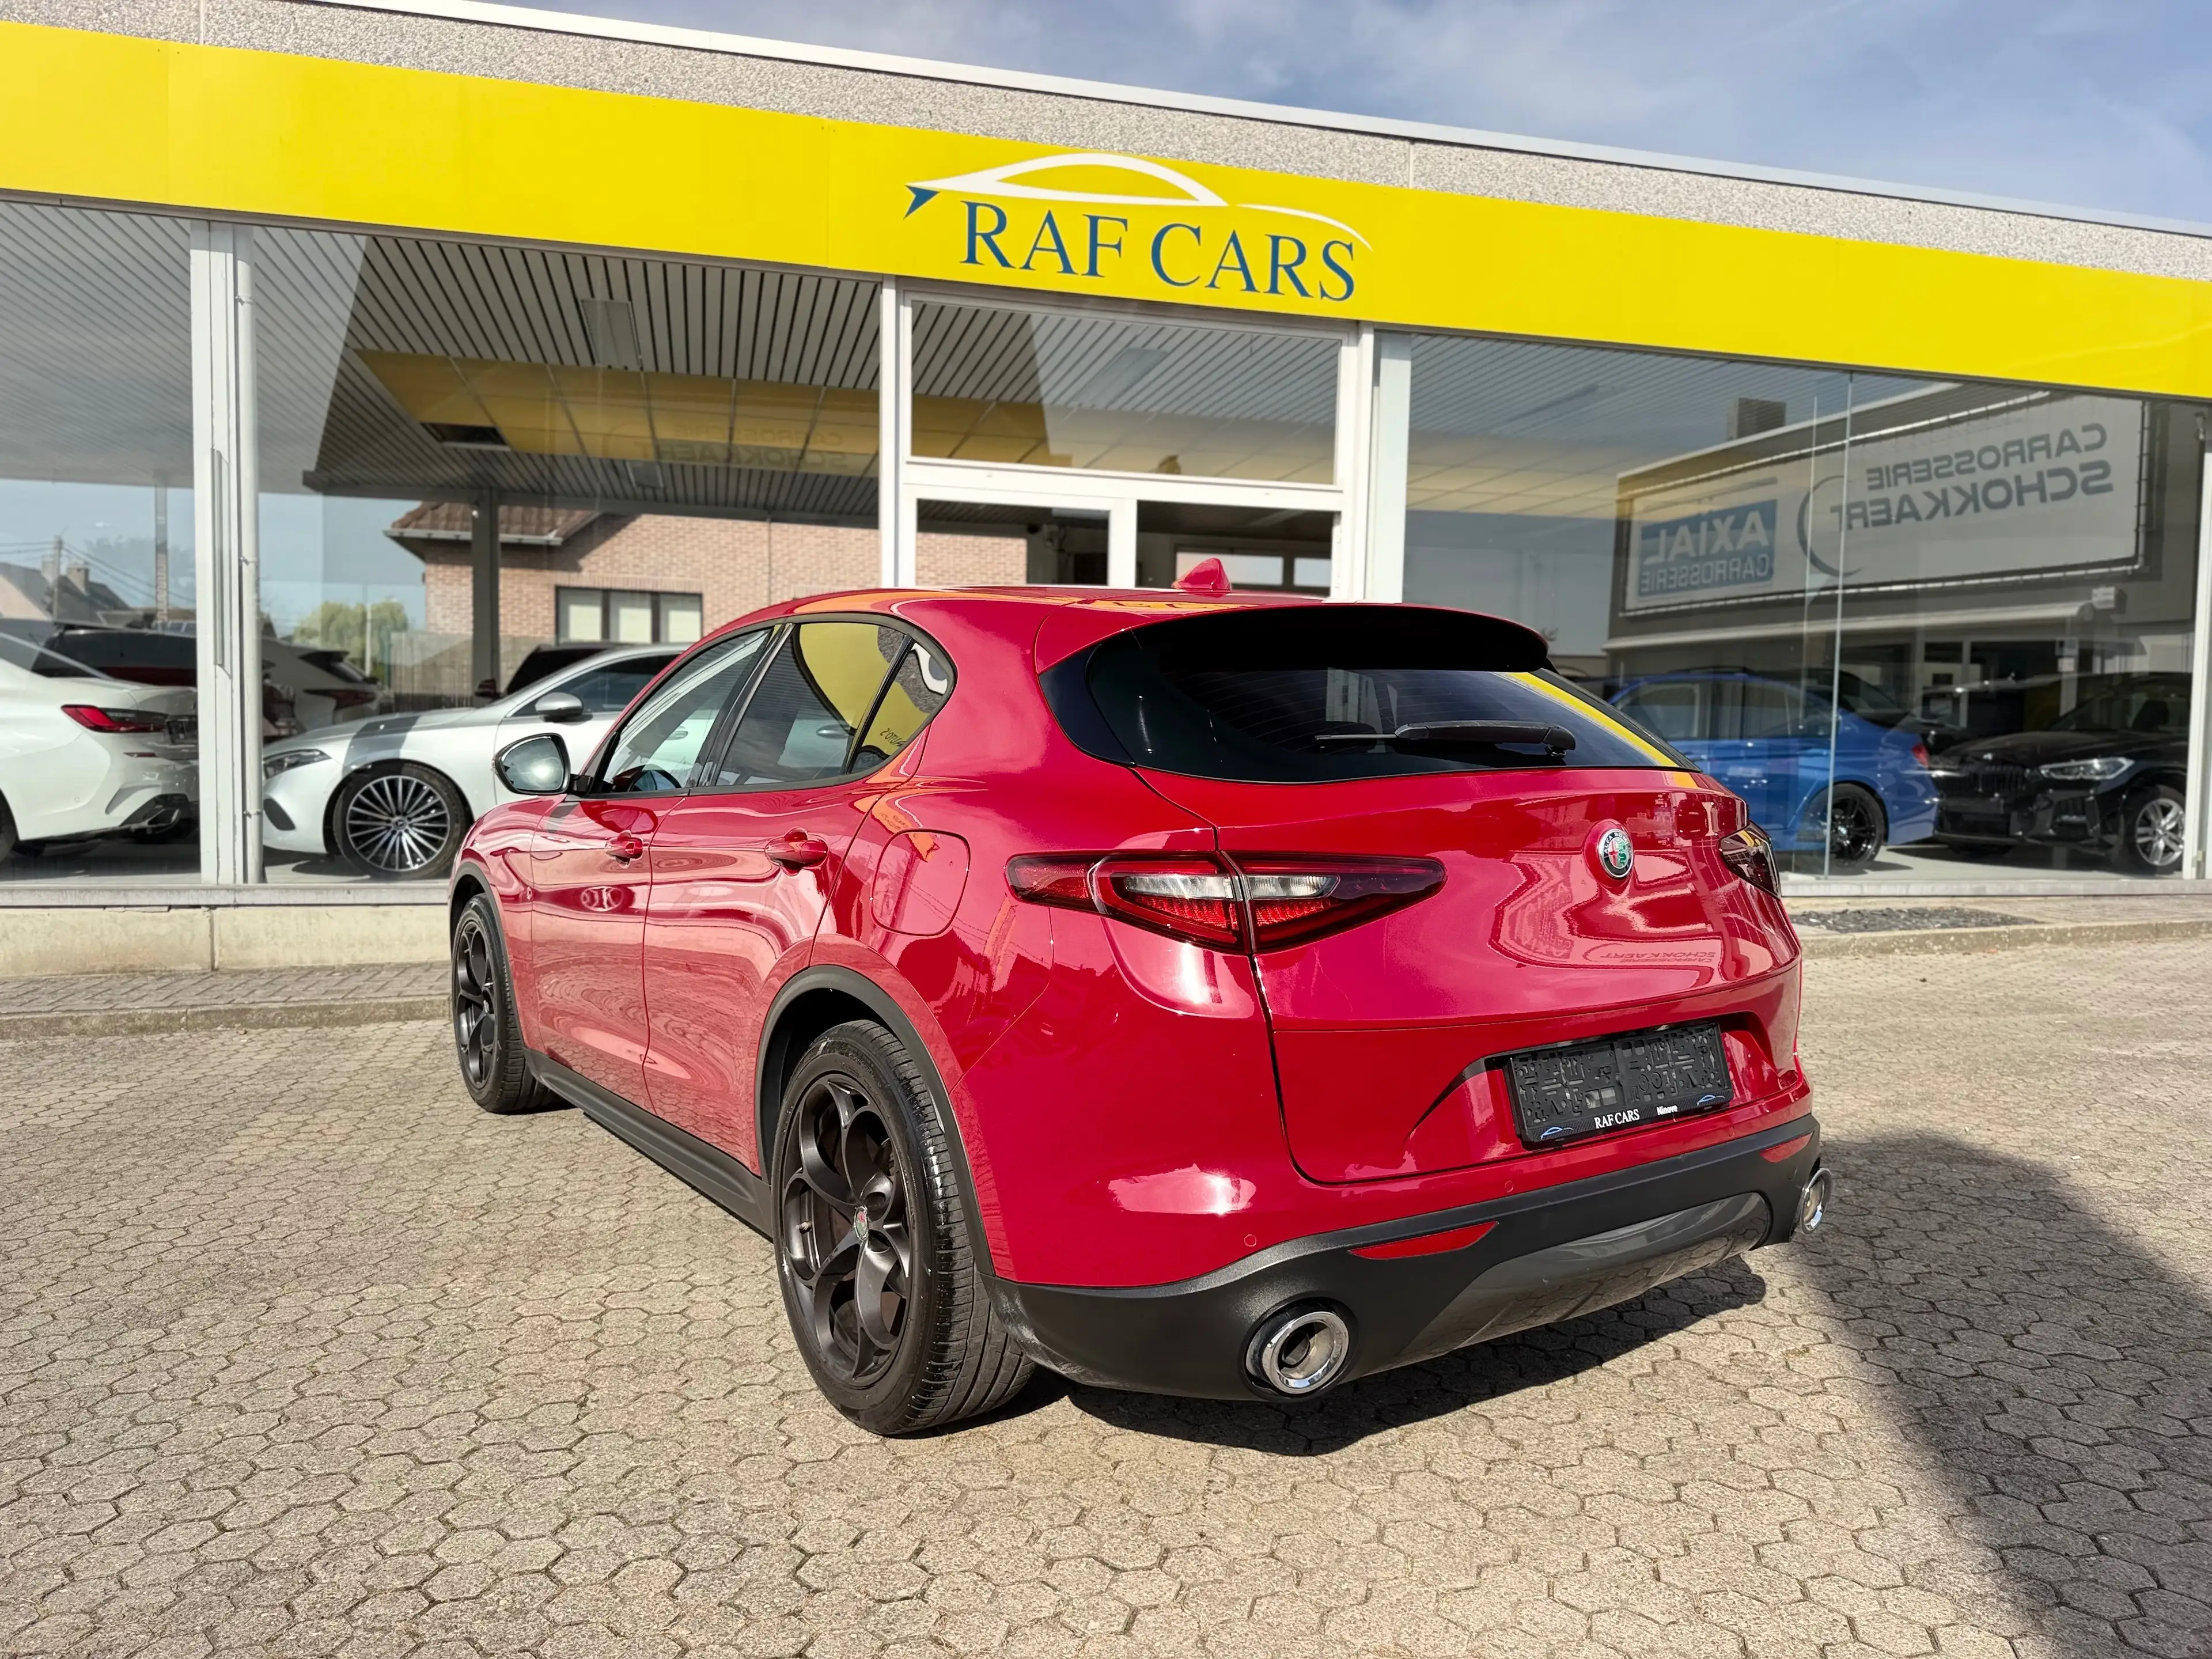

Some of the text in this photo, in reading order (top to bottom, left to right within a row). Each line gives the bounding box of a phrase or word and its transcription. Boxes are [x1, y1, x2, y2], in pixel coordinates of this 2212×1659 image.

[960, 200, 1355, 302] RAF CARS
[1604, 835, 1613, 853] ALFA
[1594, 1105, 1679, 1129] RAF CARS Ninove
